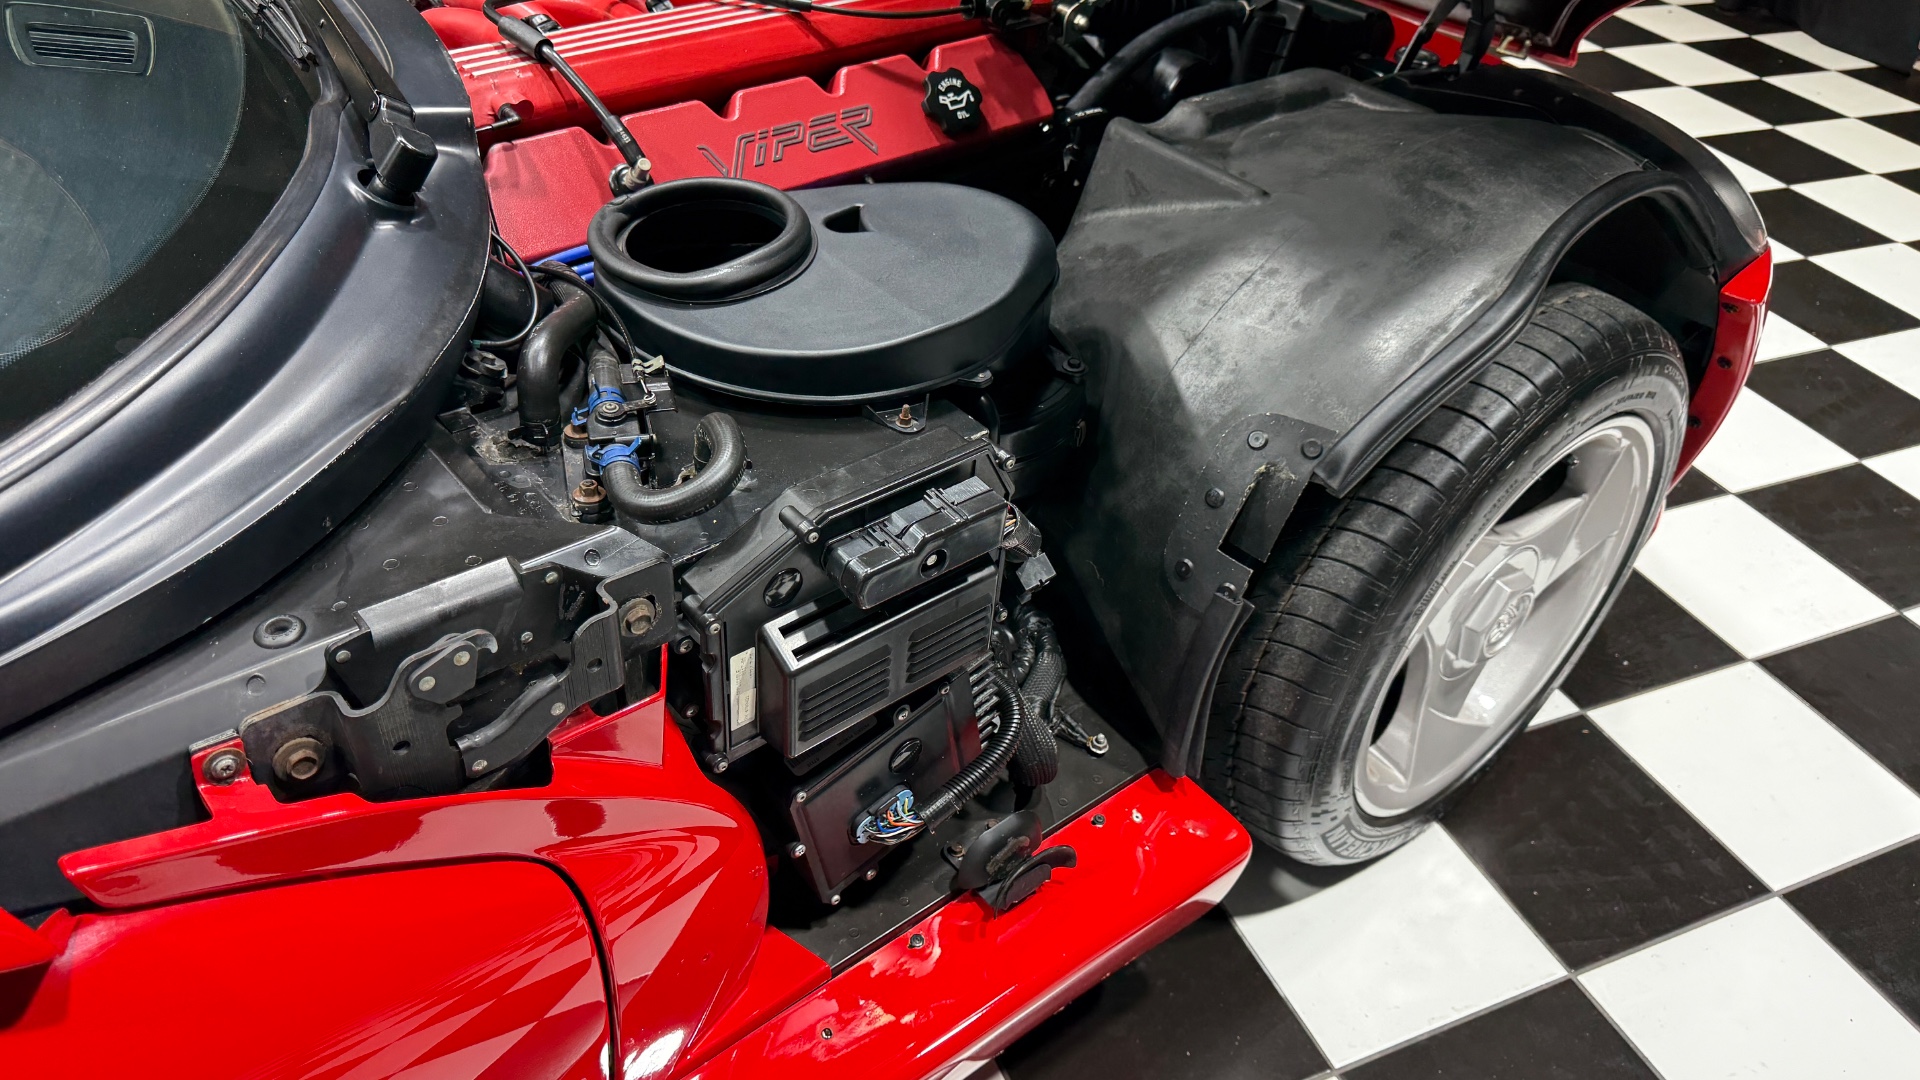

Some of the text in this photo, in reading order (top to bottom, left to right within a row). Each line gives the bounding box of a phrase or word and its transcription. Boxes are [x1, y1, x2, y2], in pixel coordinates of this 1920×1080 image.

[938, 77, 962, 92] ENGINE
[956, 110, 970, 119] OIL
[697, 104, 878, 178] VIPER
